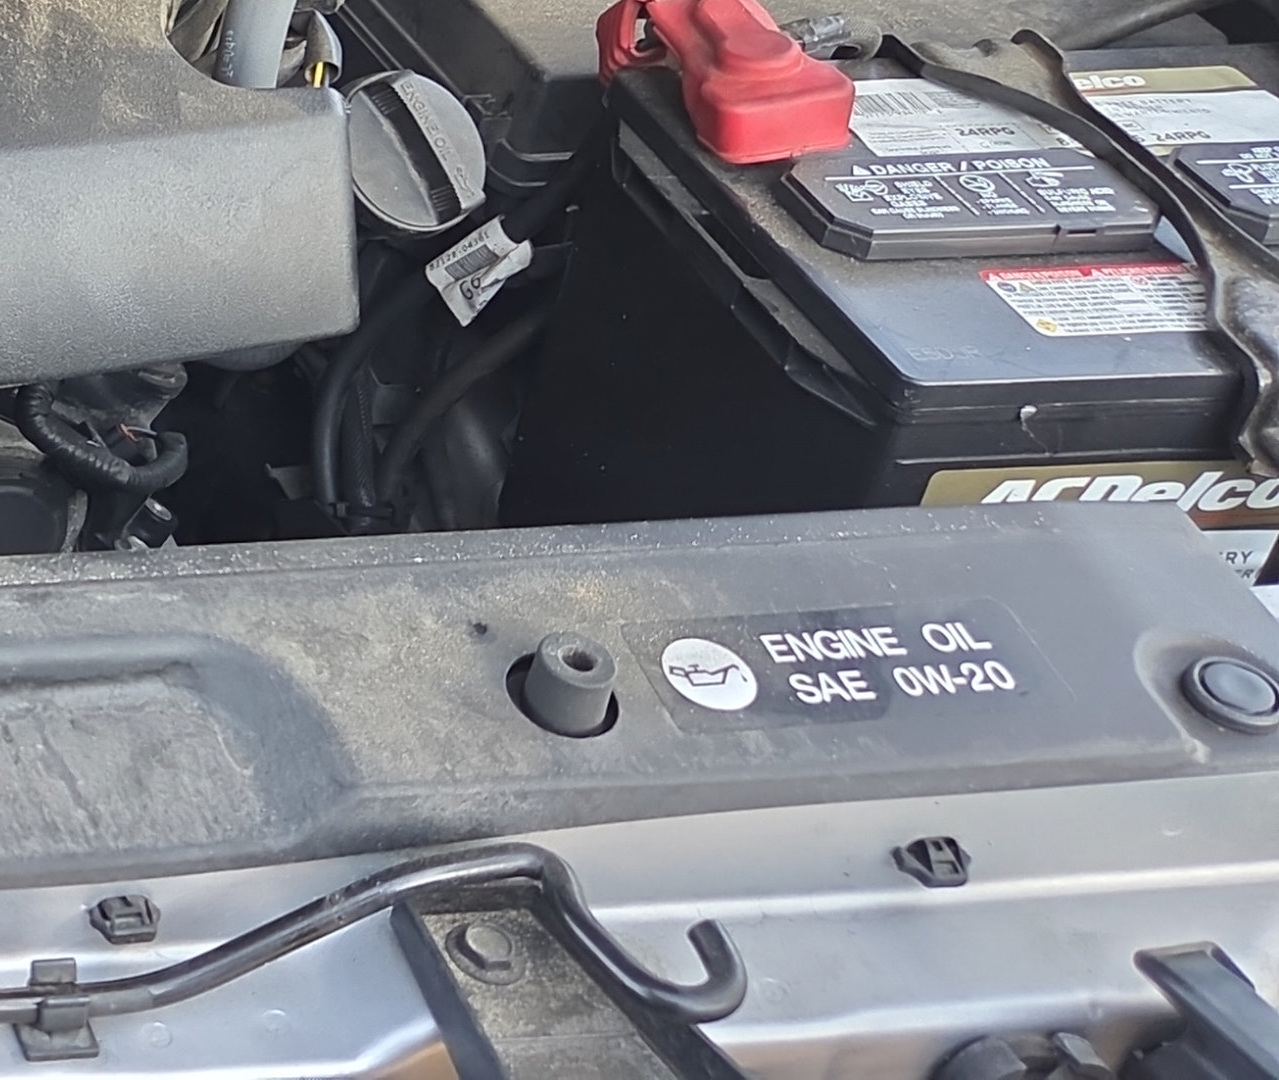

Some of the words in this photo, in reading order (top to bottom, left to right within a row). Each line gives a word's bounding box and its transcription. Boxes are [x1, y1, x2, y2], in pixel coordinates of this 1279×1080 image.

[400, 80, 439, 136] ENGINE
[434, 135, 455, 162] OIL
[953, 126, 1016, 138] 24RPG
[1150, 130, 1212, 142] 24RPG
[869, 161, 956, 176] DANGER
[972, 157, 1051, 171] POISON
[460, 274, 483, 302] G6
[760, 626, 907, 664] ENGINE
[921, 621, 992, 653] OIL
[788, 669, 877, 704] SAE
[892, 659, 1016, 697] 0W-20
